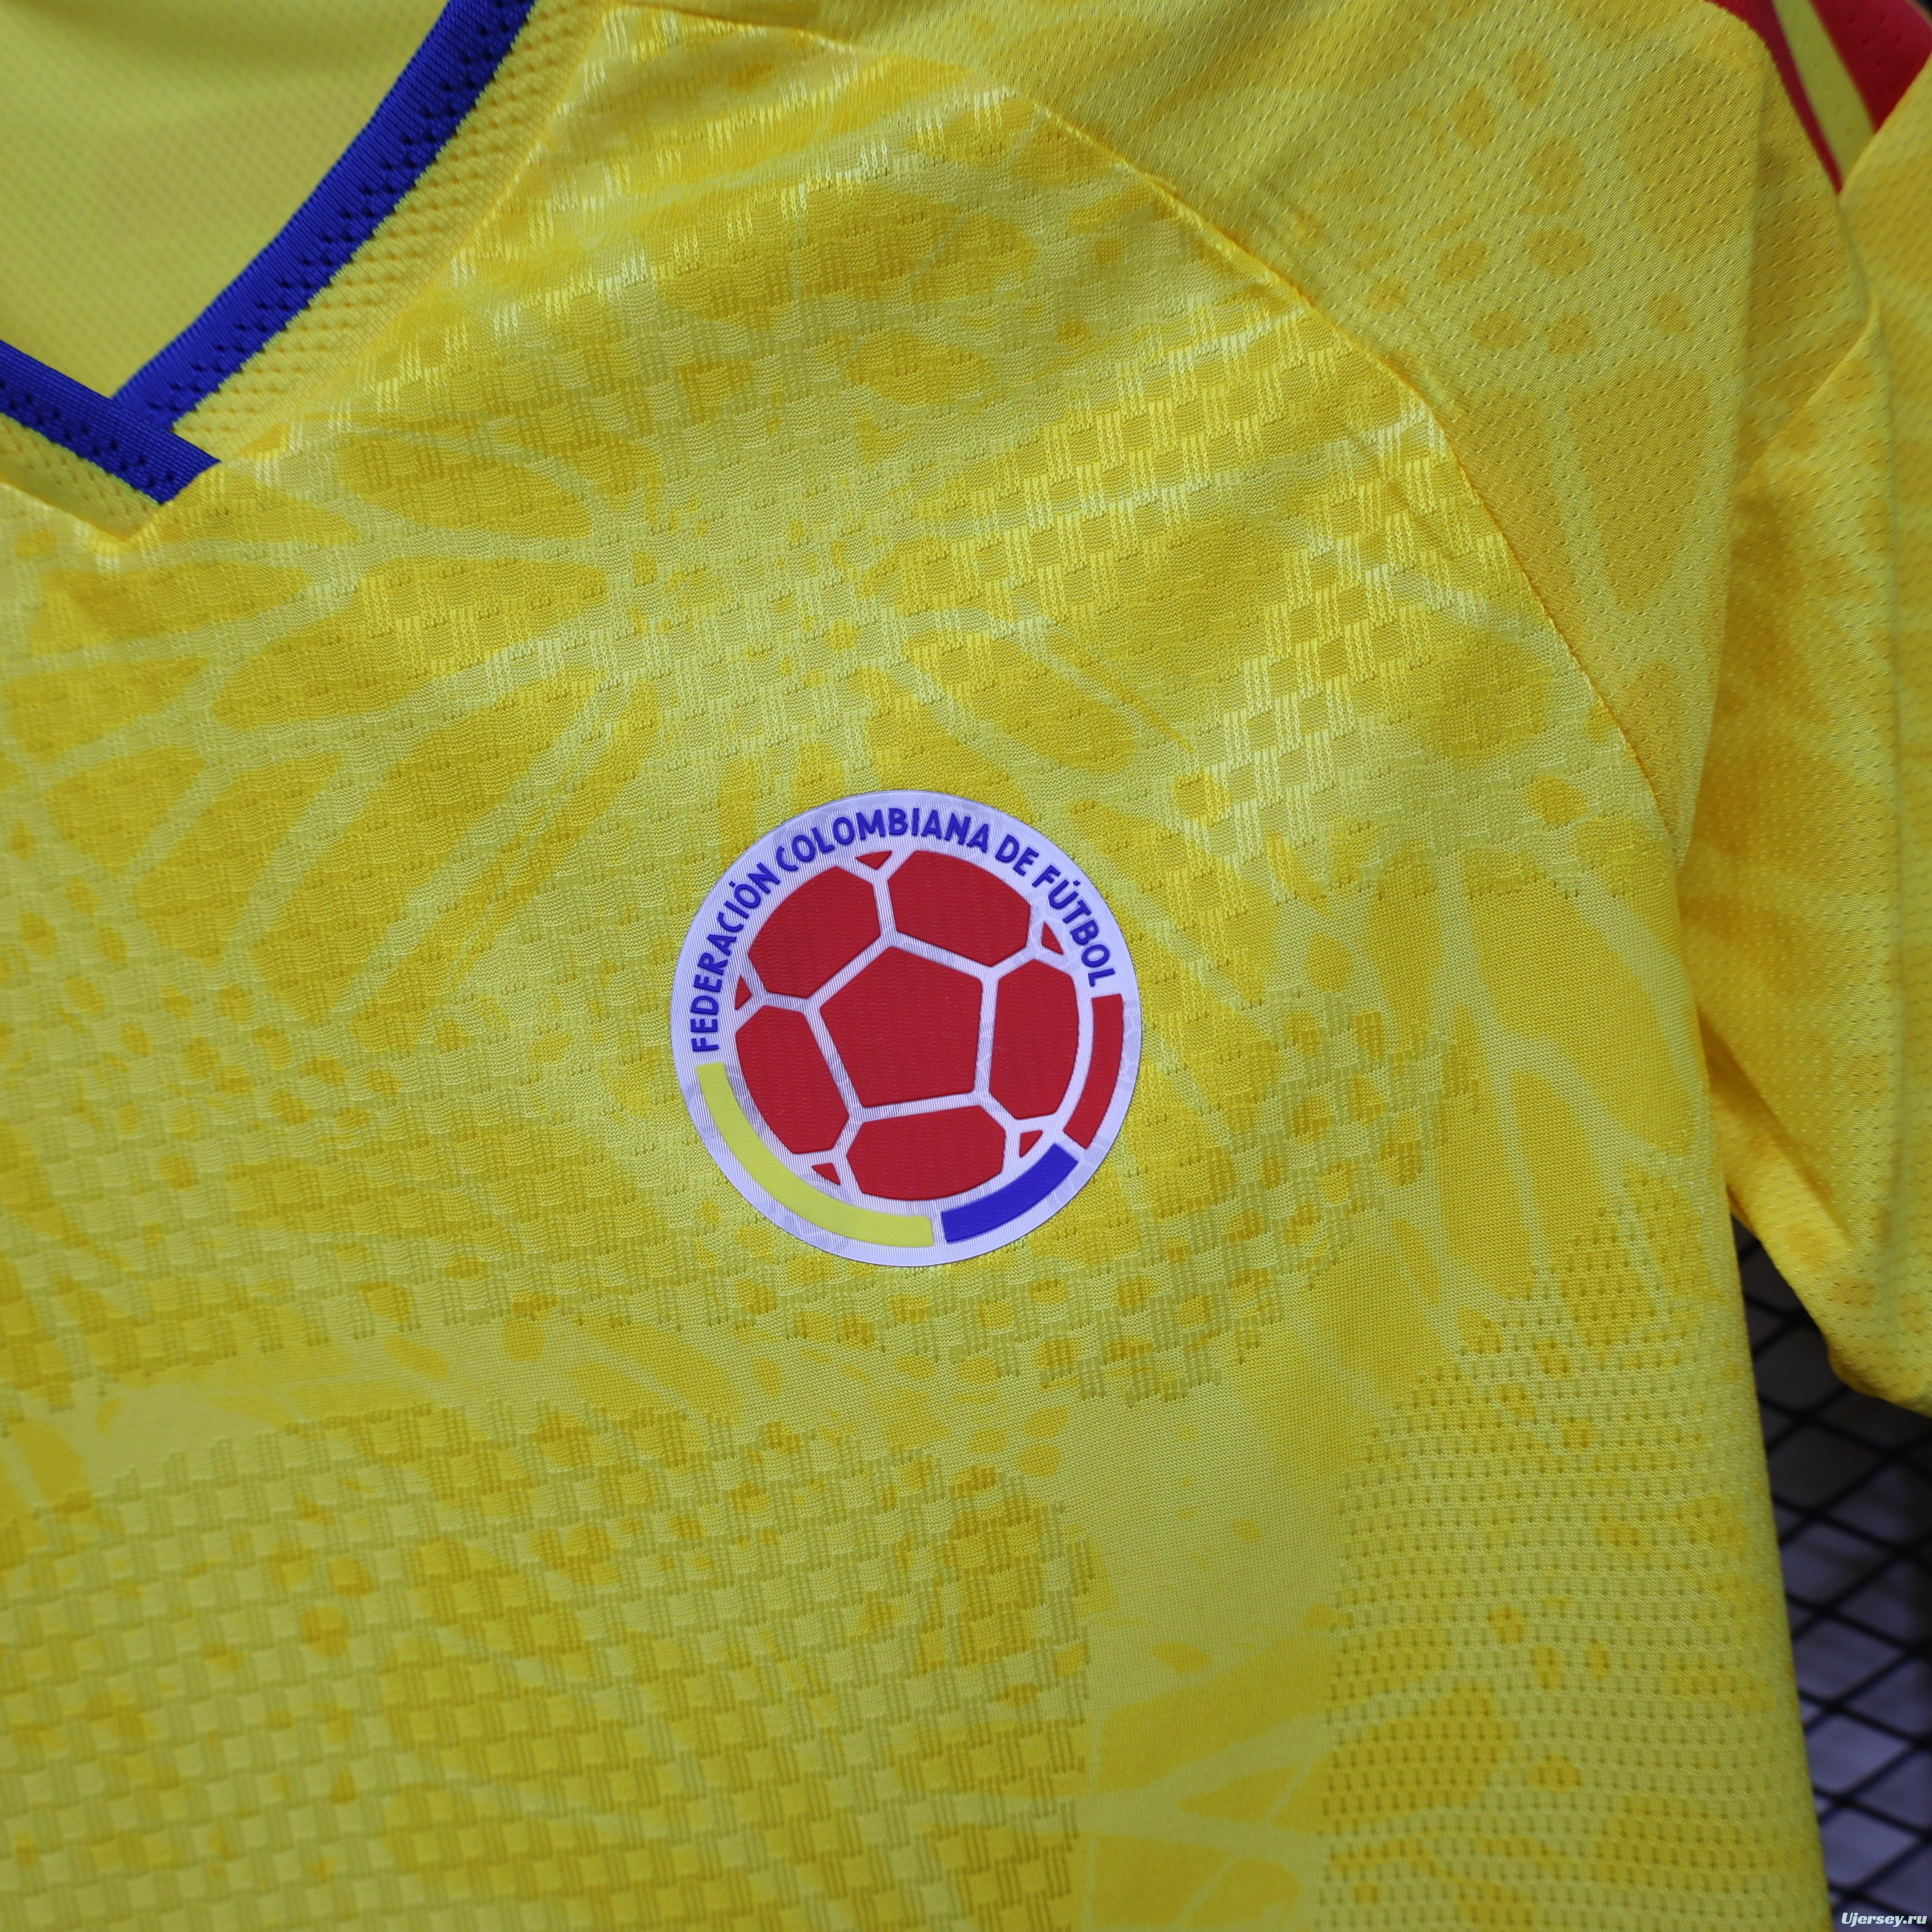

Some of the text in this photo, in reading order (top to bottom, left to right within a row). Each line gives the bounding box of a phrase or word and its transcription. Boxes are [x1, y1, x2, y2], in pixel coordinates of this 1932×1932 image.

[689, 807, 1116, 1052] FEDERACIÓN COLOMBIANA DE FÚTBOL
